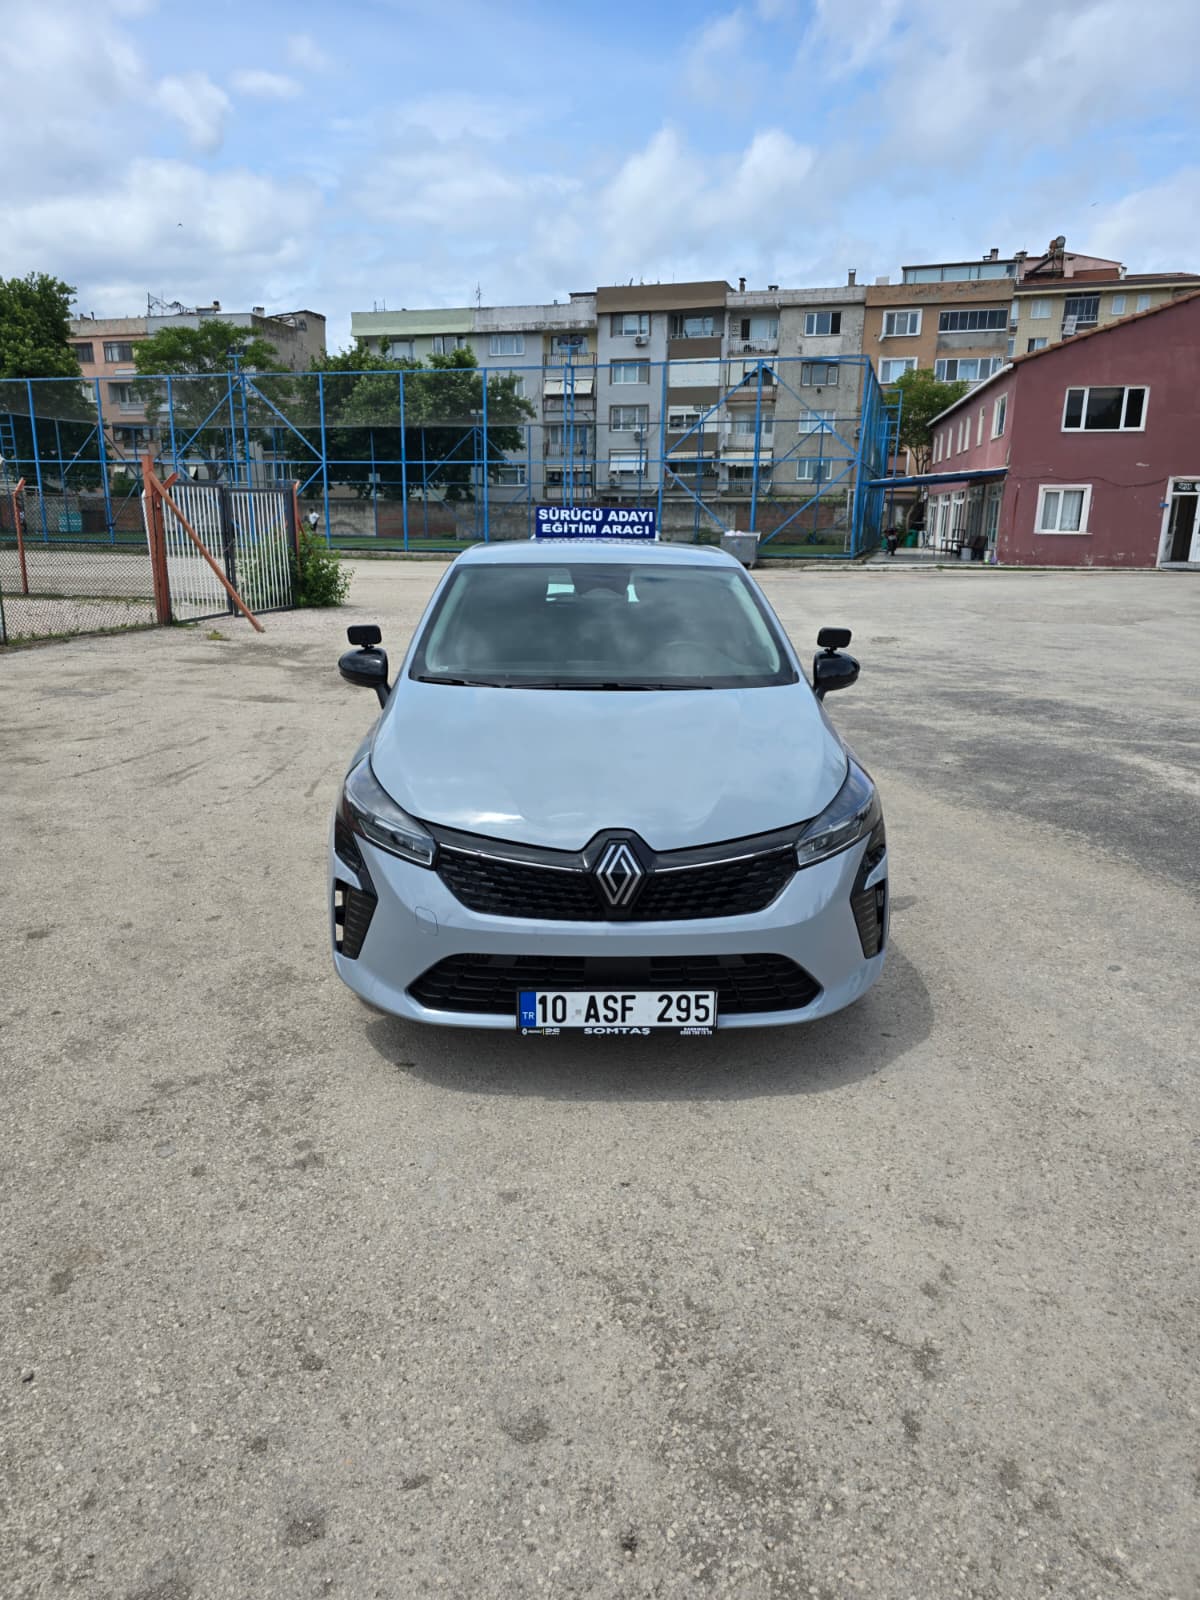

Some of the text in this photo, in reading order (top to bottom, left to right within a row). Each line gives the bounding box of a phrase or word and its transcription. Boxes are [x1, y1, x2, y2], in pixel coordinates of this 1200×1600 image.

[538, 507, 653, 522] SÜRÜCÜ ADAYI
[541, 522, 650, 535] EĞİTİM ARACI
[522, 994, 710, 1023] TR 10 ASF 295
[583, 1027, 651, 1036] SOMTAŞ
